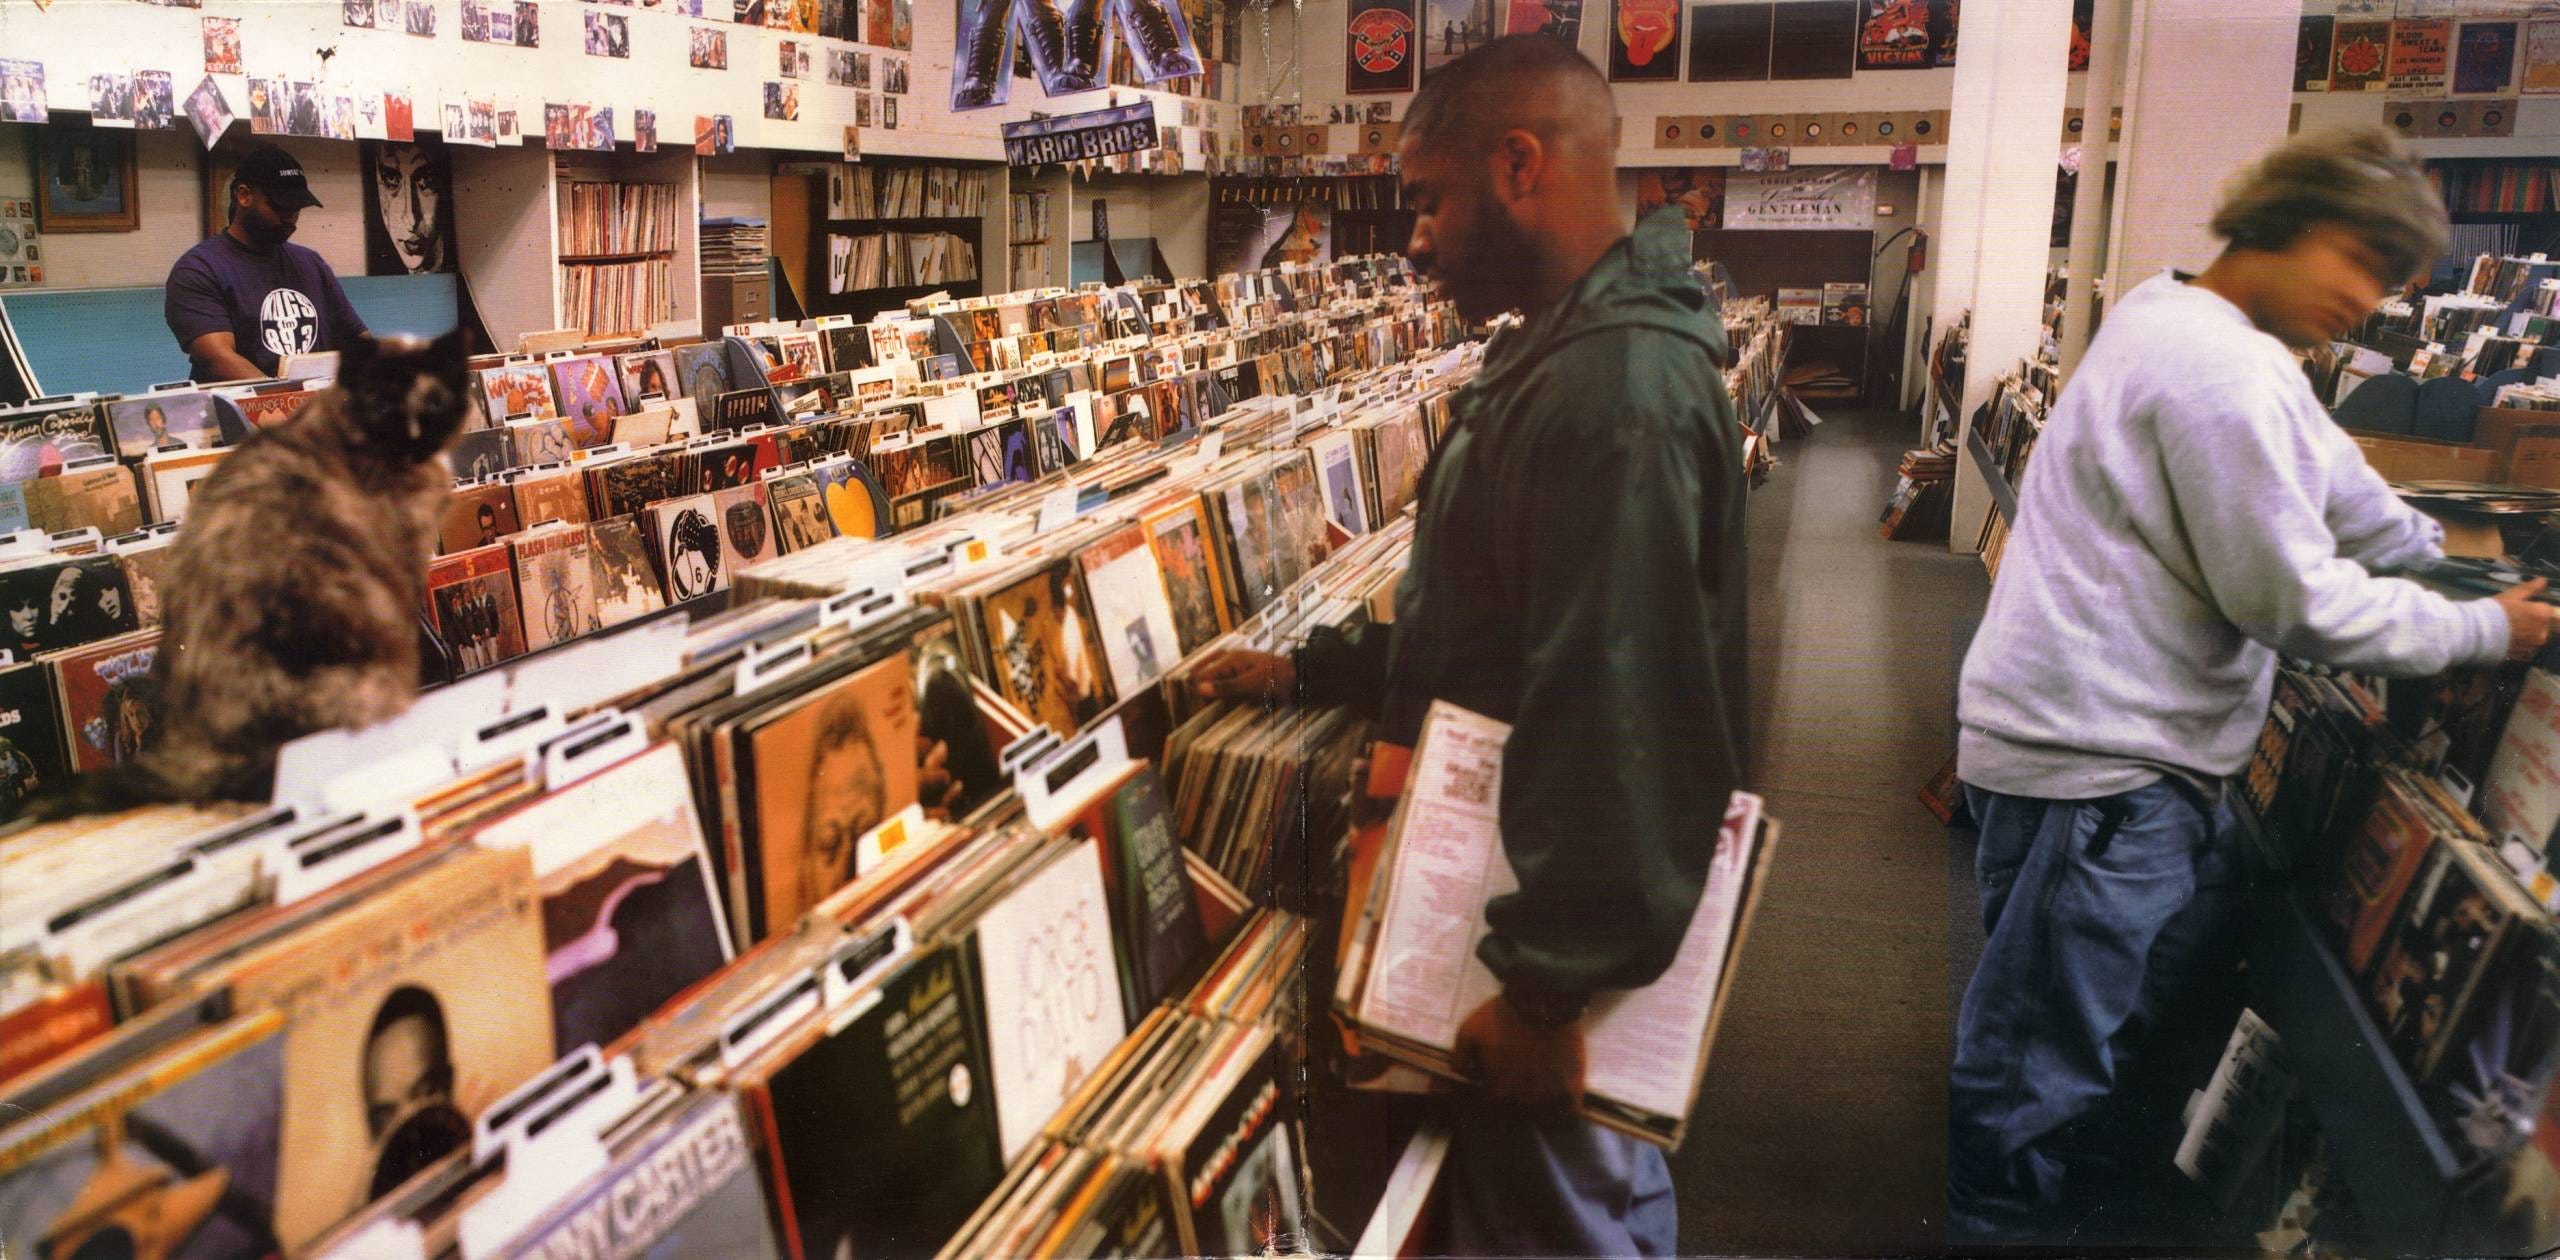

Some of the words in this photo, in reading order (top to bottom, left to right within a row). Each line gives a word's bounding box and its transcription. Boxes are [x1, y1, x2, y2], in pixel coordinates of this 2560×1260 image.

[1866, 50, 1921, 64] VICTIM
[1006, 134, 1080, 167] MARIO
[1747, 203, 1842, 215] GENTLEMAN
[733, 325, 750, 336] ELO
[42, 411, 96, 435] Cassidy
[464, 558, 476, 577] 5
[694, 568, 704, 584] 6
